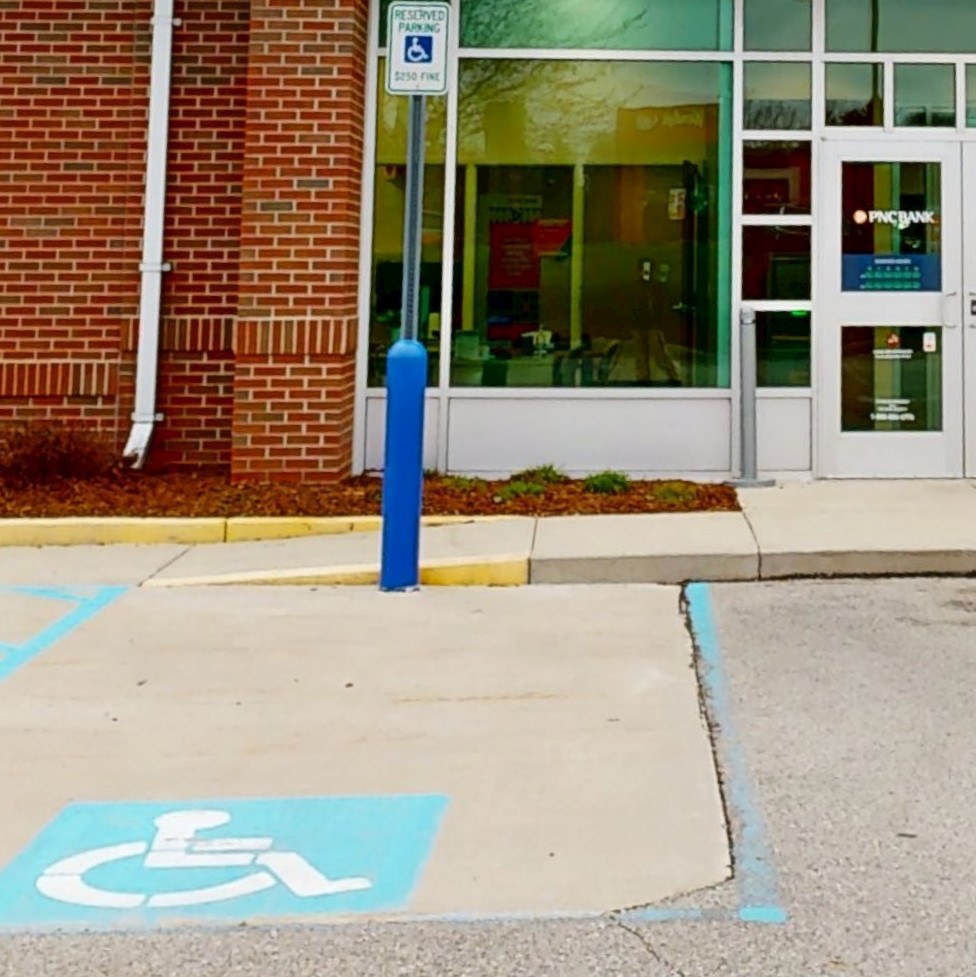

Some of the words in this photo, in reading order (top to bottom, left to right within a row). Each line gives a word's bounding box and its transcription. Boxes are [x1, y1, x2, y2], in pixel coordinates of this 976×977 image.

[394, 9, 445, 21] RESERVED
[398, 23, 441, 33] PARKING
[420, 71, 441, 82] FINE
